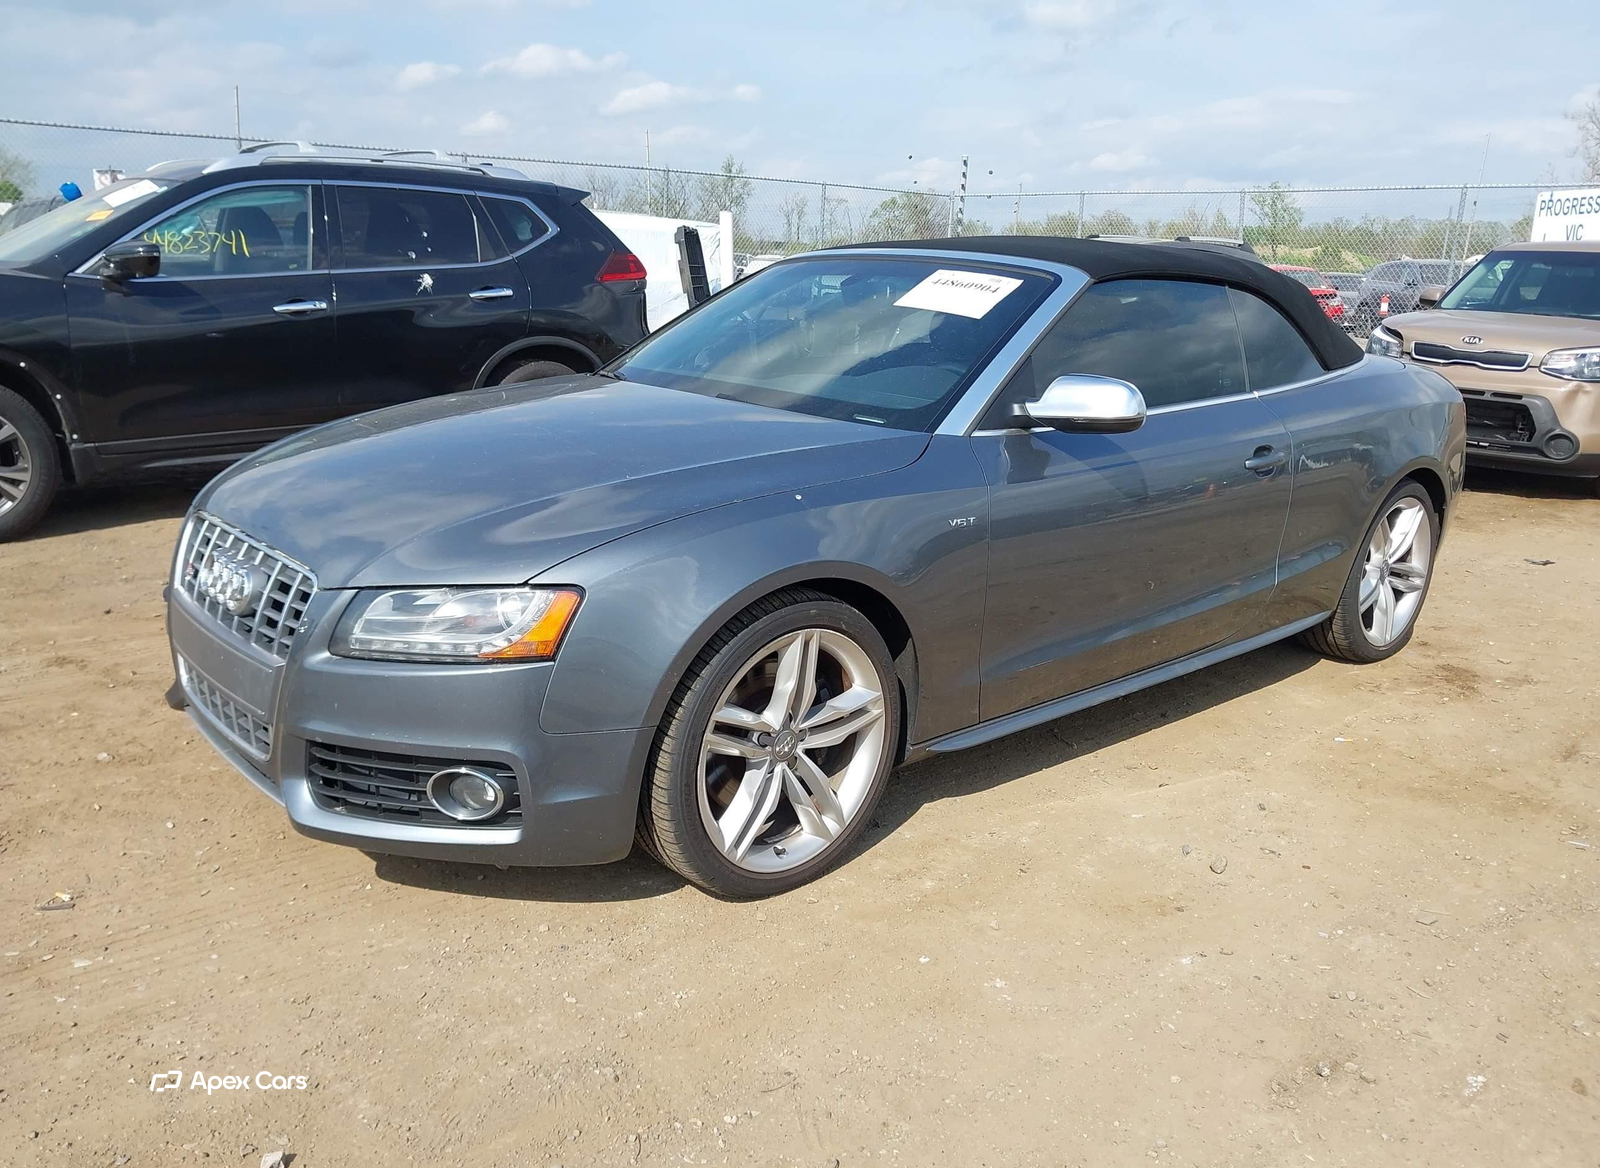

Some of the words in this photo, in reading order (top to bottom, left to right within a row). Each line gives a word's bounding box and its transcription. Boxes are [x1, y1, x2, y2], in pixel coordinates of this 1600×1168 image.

[1538, 195, 1600, 217] PROGRESS
[143, 229, 250, 258] 44823741
[1462, 336, 1481, 345] KIA
[948, 516, 977, 528] V6T
